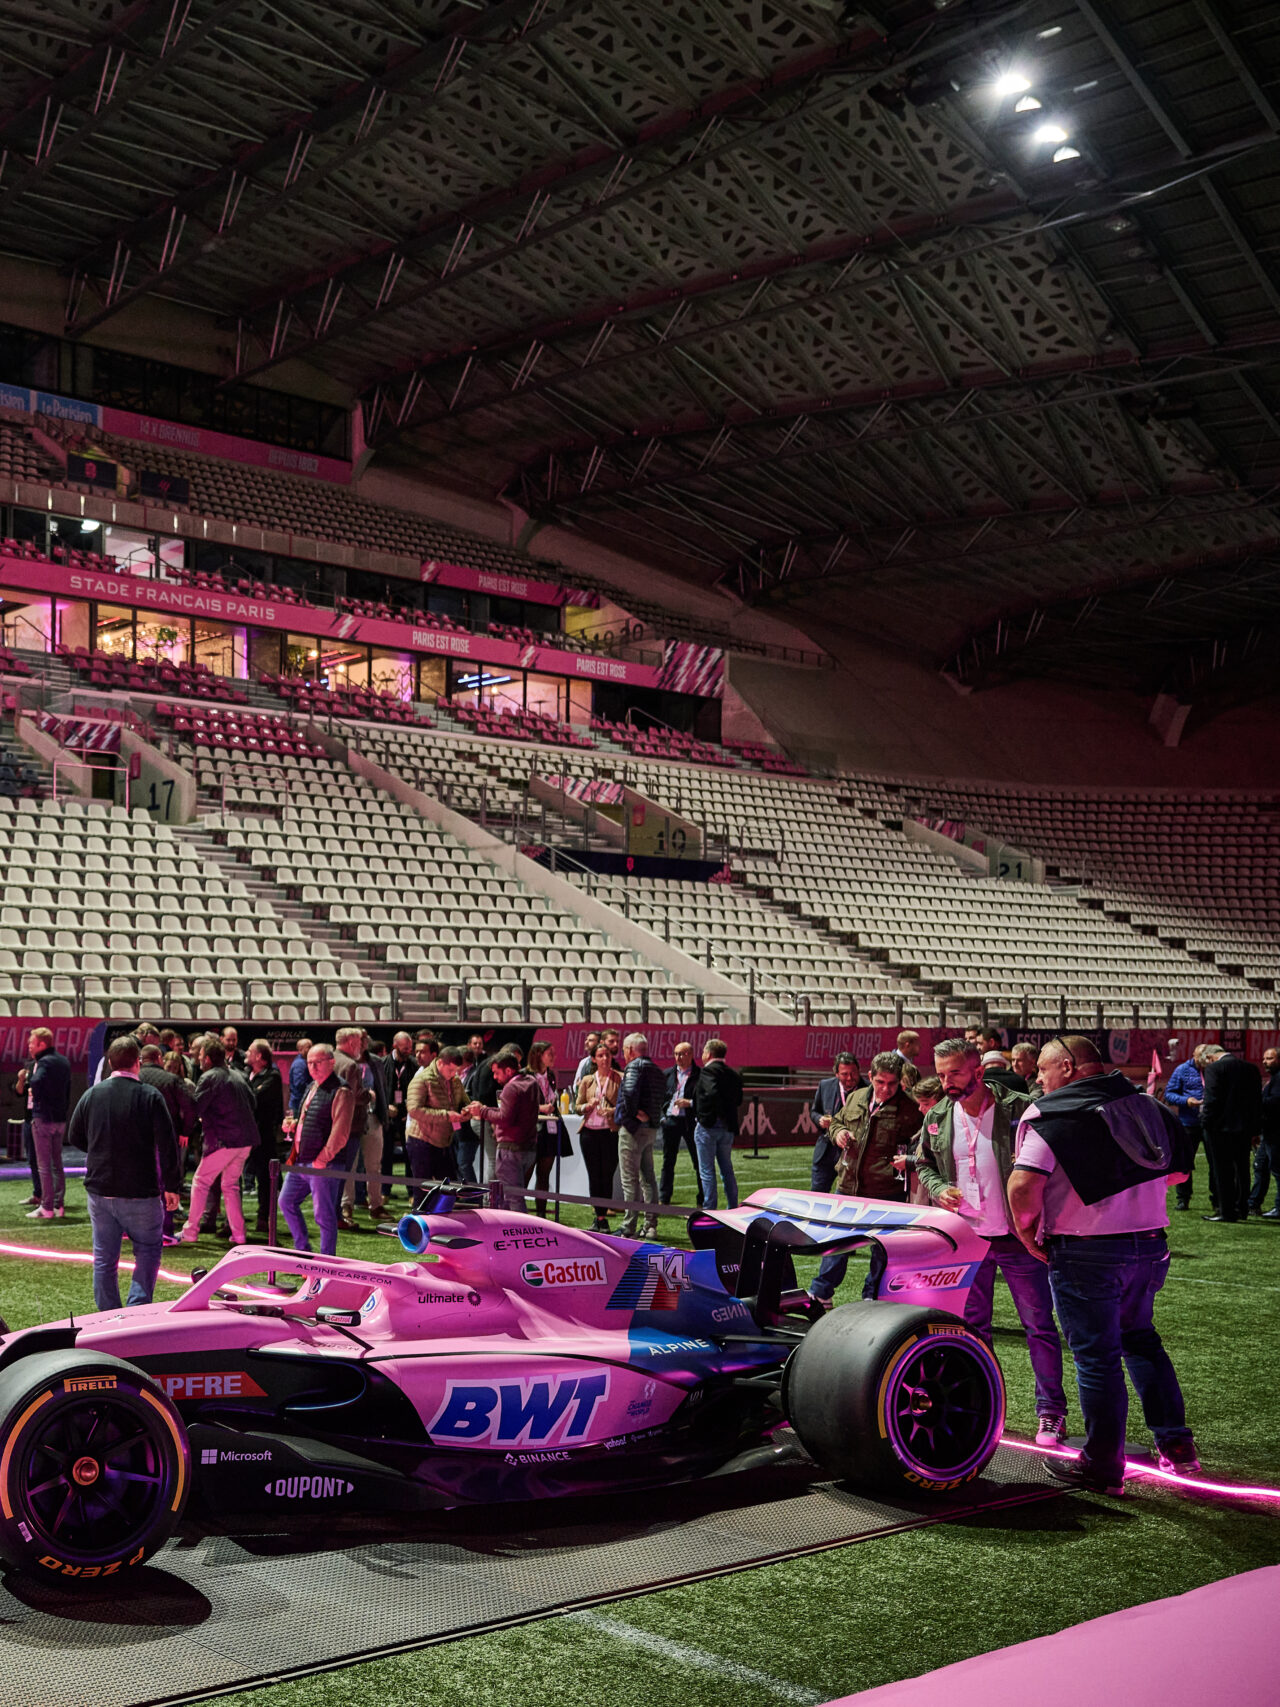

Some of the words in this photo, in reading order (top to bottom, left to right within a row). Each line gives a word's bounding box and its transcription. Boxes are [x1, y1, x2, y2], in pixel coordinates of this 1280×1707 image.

[478, 574, 498, 592] PARIS
[498, 578, 511, 594] EST
[511, 581, 528, 596] ROSE
[70, 575, 129, 597] STADE
[226, 601, 276, 620] PARIS
[412, 630, 435, 648] PARIS
[436, 634, 450, 651] EST
[450, 636, 470, 654] ROSE
[576, 657, 596, 674] PARIS
[596, 661, 609, 676] EST
[609, 663, 627, 680] ROSE
[148, 780, 175, 820] 17
[805, 1032, 850, 1060] DEPUIS
[852, 1032, 882, 1060] 1883
[503, 1226, 544, 1237] RENAULT
[494, 1237, 558, 1251] E-TECH
[296, 1263, 392, 1285] ALPINECARS.COM
[543, 1260, 604, 1284] Castrol
[647, 1253, 693, 1292] 14
[906, 1266, 964, 1290] Castrol
[418, 1293, 464, 1304] ultimate
[648, 1337, 710, 1356] ALPINE
[63, 1374, 118, 1393] PIRELLI
[431, 1373, 608, 1444] BWT
[220, 1450, 273, 1463] Microsoft
[518, 1451, 573, 1465] BINANCE
[275, 1476, 346, 1499] DUPONT
[37, 1555, 123, 1578] ZERO
